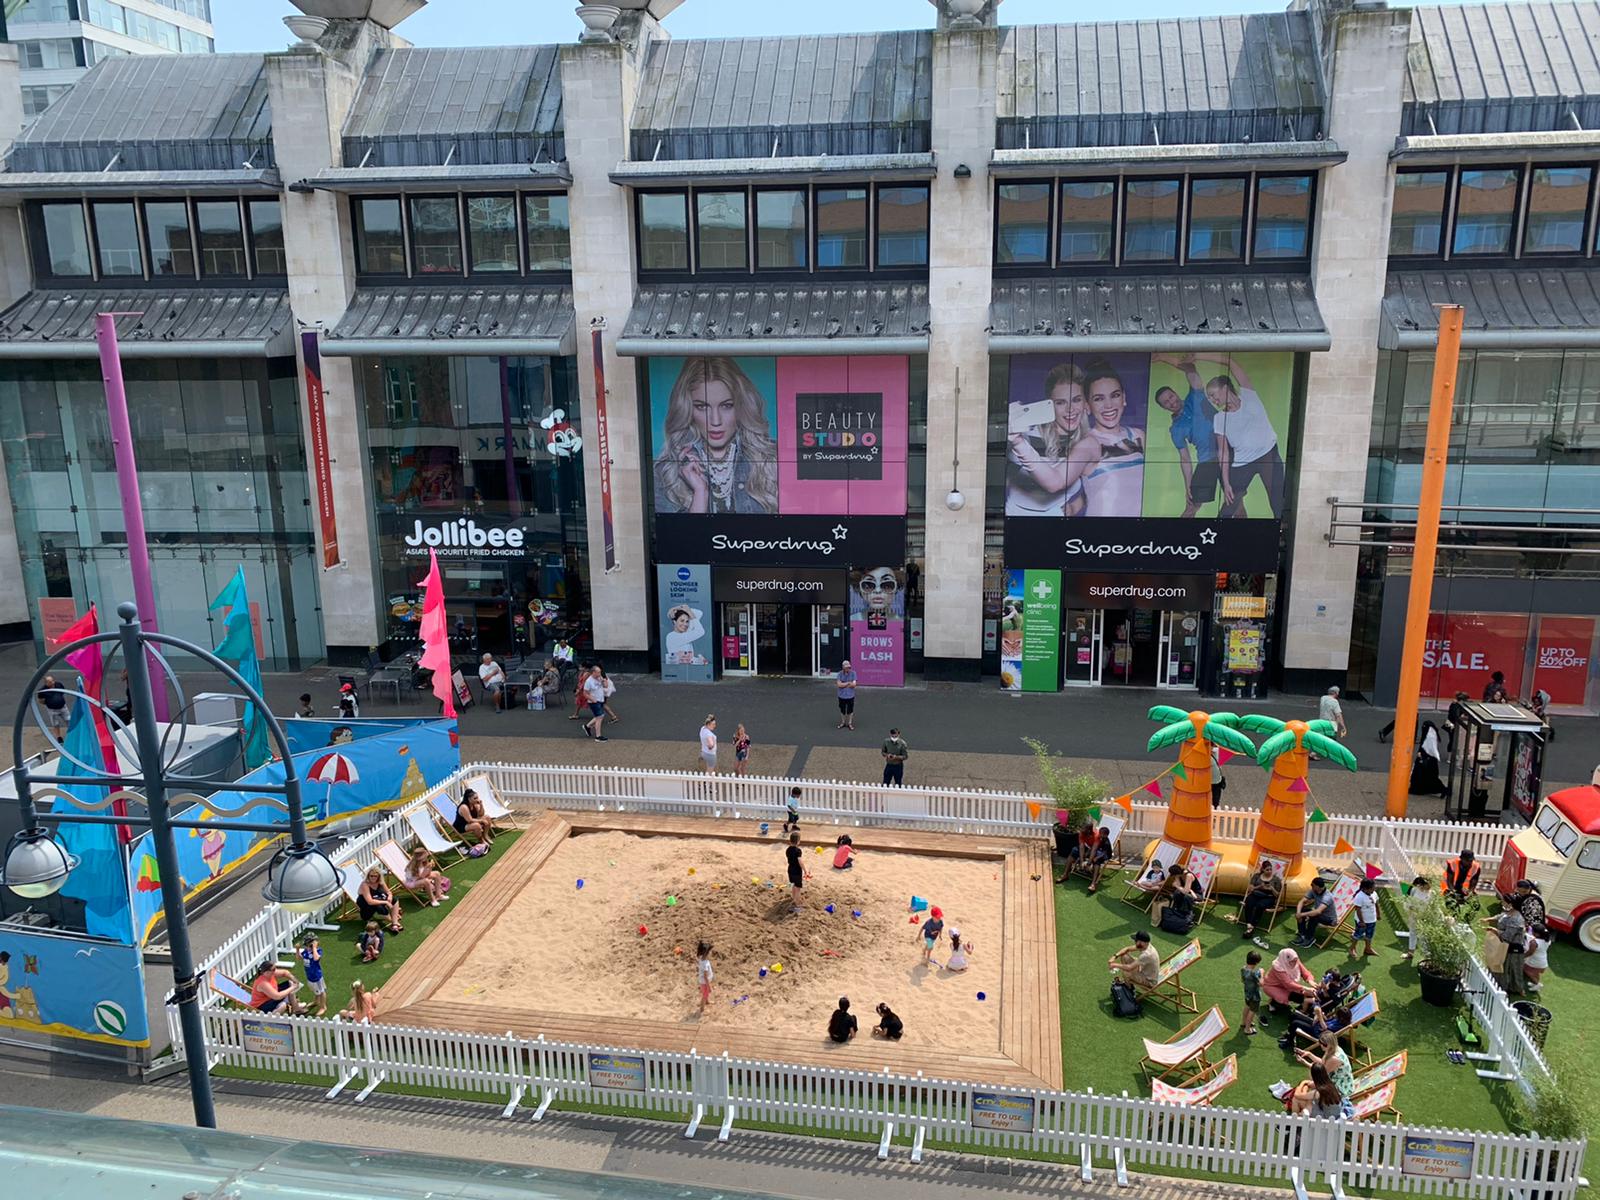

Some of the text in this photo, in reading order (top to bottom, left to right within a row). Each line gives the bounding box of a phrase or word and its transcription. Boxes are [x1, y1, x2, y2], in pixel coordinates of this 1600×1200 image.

[802, 412, 876, 430] BEAUTY
[802, 432, 877, 447] STUDIO
[598, 409, 609, 493] Jollibee
[814, 452, 874, 461] Superdrug
[314, 412, 323, 456] FAVOURITE
[321, 482, 330, 517] CHICKEN
[405, 518, 524, 547] Jollibee
[712, 534, 836, 555] Superdrug
[1065, 538, 1202, 560] Superdrug
[406, 548, 525, 557] ASIA'S AVOURITE FRIED CHICKEN
[736, 579, 824, 593] superdrug.com
[1089, 585, 1186, 599] superdrug.com
[1026, 602, 1057, 610] wellbeing
[860, 637, 893, 648] BROWS
[1425, 639, 1451, 650] THE
[860, 652, 893, 661] LASH
[1541, 647, 1576, 658] UP TO
